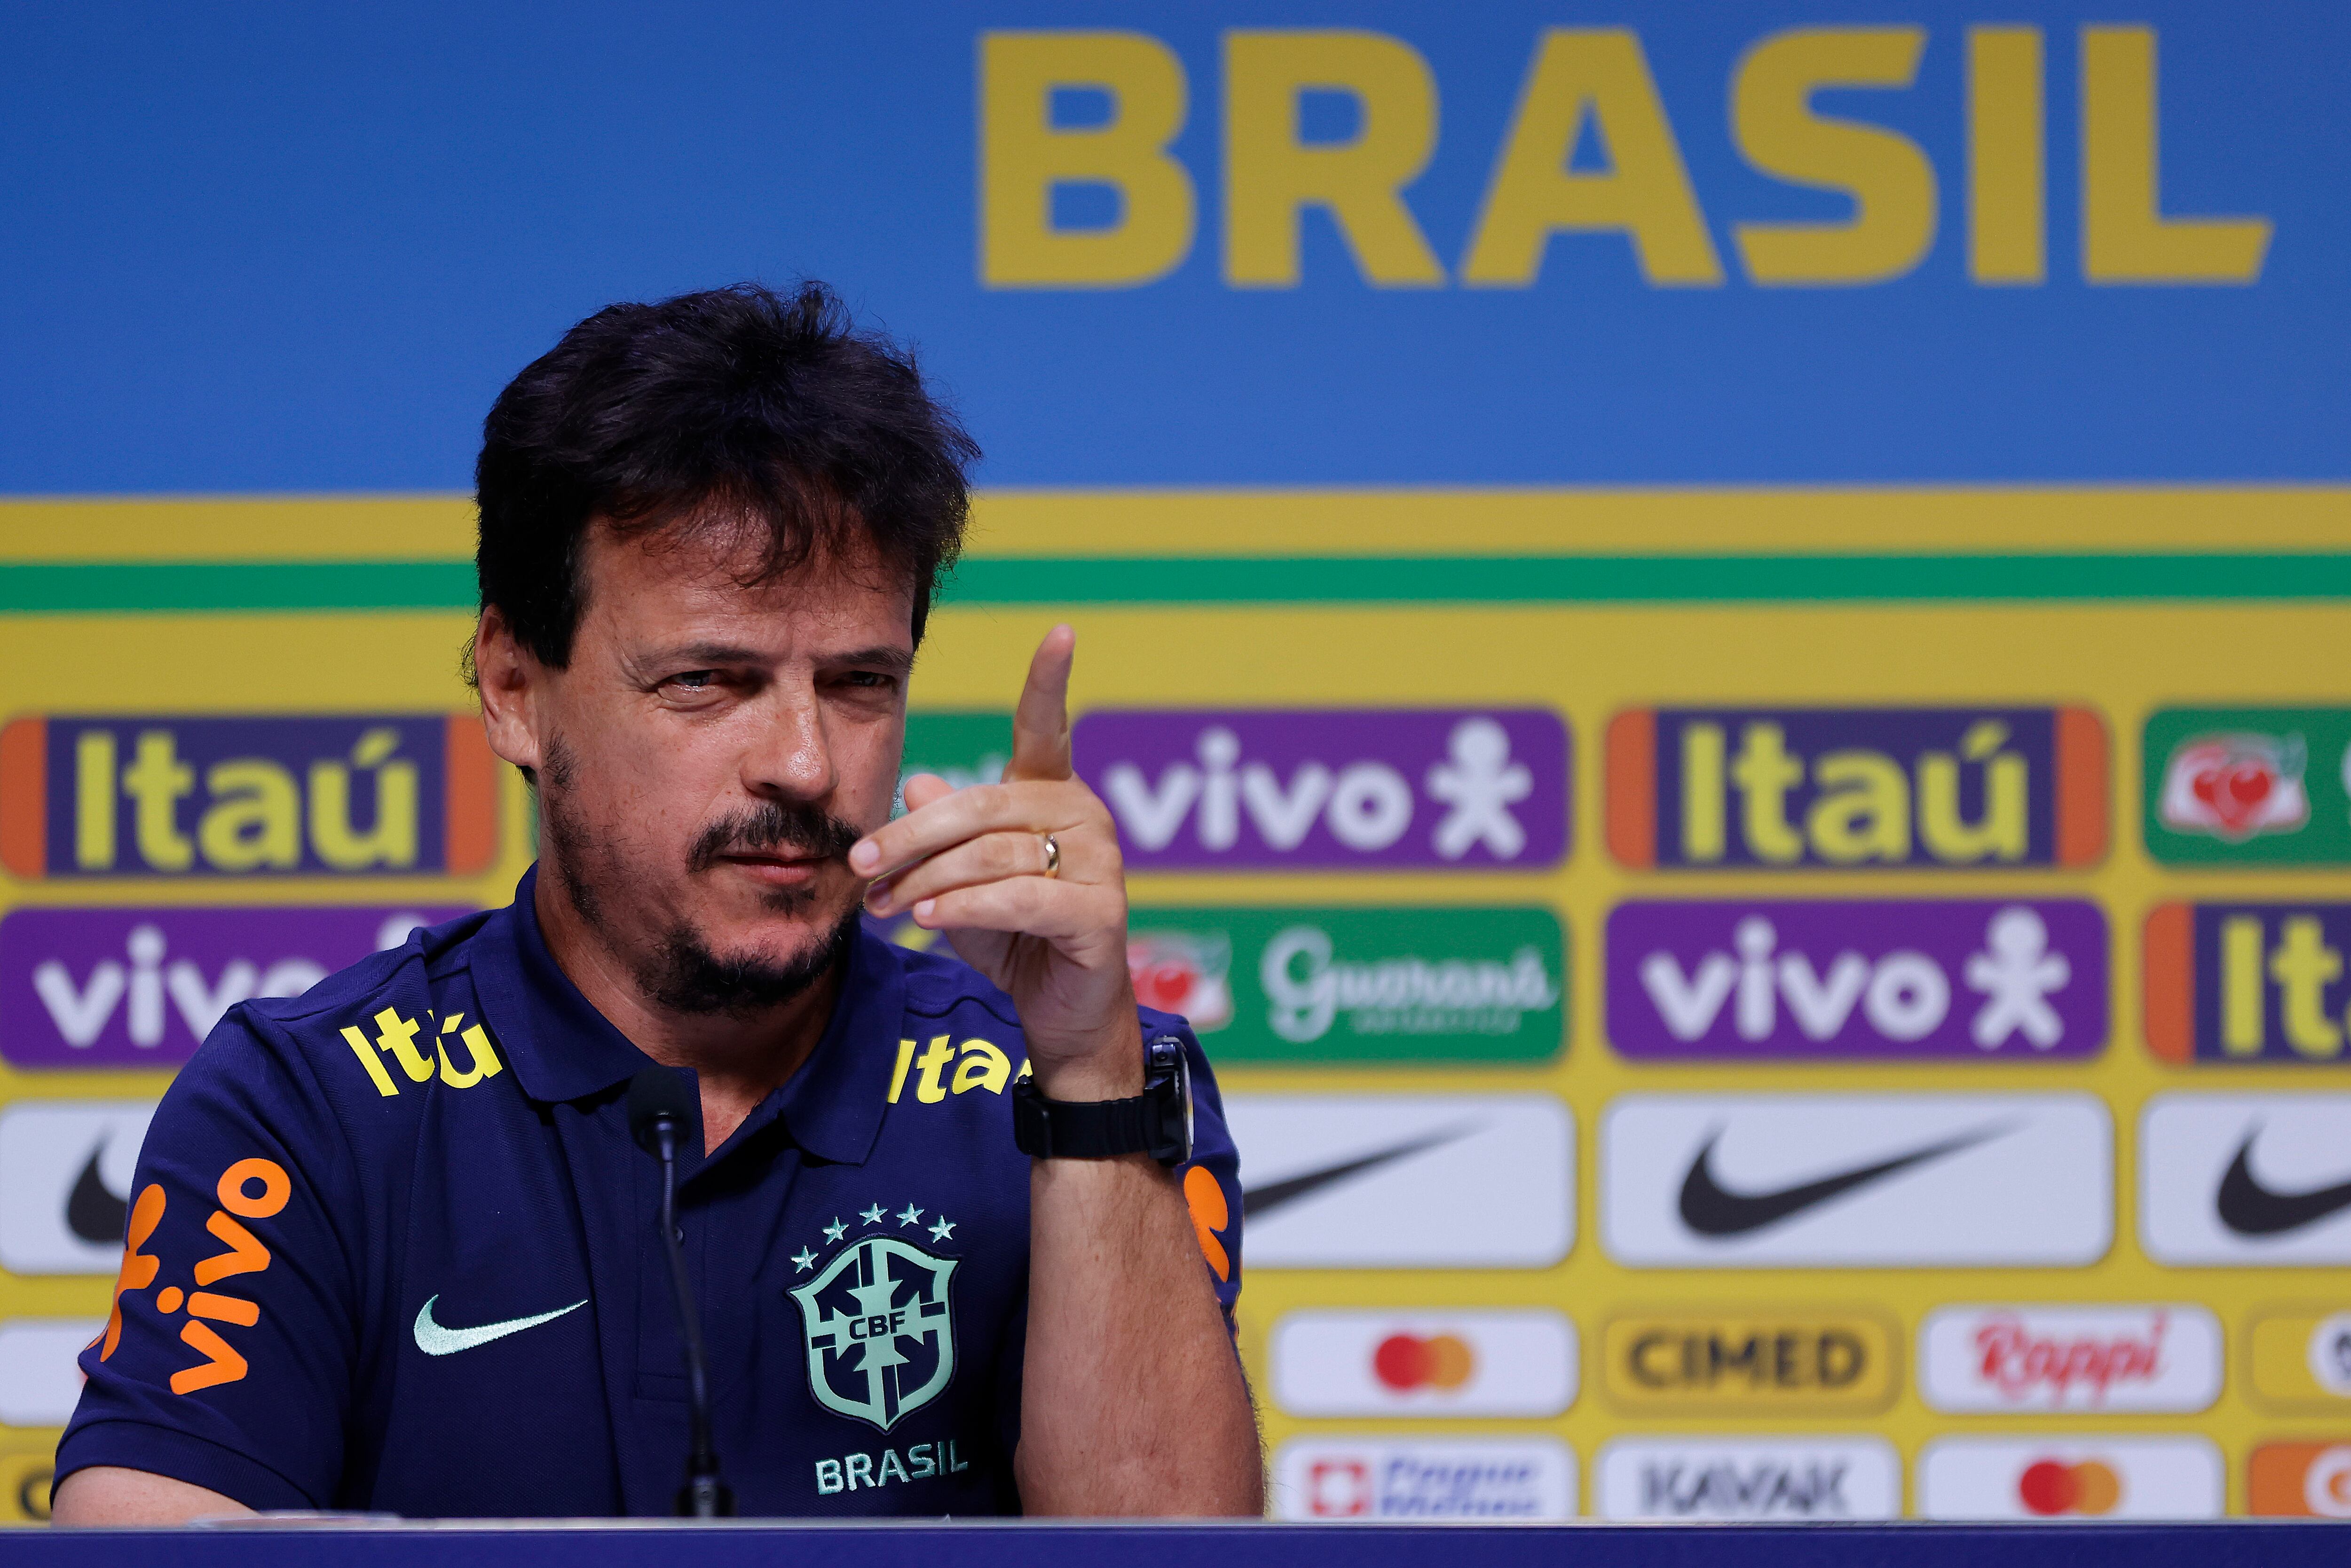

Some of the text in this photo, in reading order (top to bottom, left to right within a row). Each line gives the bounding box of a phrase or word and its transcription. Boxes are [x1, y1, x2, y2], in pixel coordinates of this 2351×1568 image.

[979, 23, 2275, 290] BRASIL
[74, 727, 420, 872] Itaú
[1101, 725, 1413, 852] vivo
[1680, 719, 2030, 864] Itaú
[1638, 914, 1951, 1042] vivo
[2219, 914, 2351, 1061] It
[339, 1006, 503, 1097] Itú
[887, 1034, 1033, 1104] Ita
[156, 1158, 292, 1395] vivo
[849, 1311, 906, 1340] CBF
[1625, 1328, 1870, 1390] CIMED
[1970, 1308, 2169, 1409] Rappi
[814, 1440, 969, 1495] BRASIL
[1641, 1457, 1853, 1515] KAVAK
